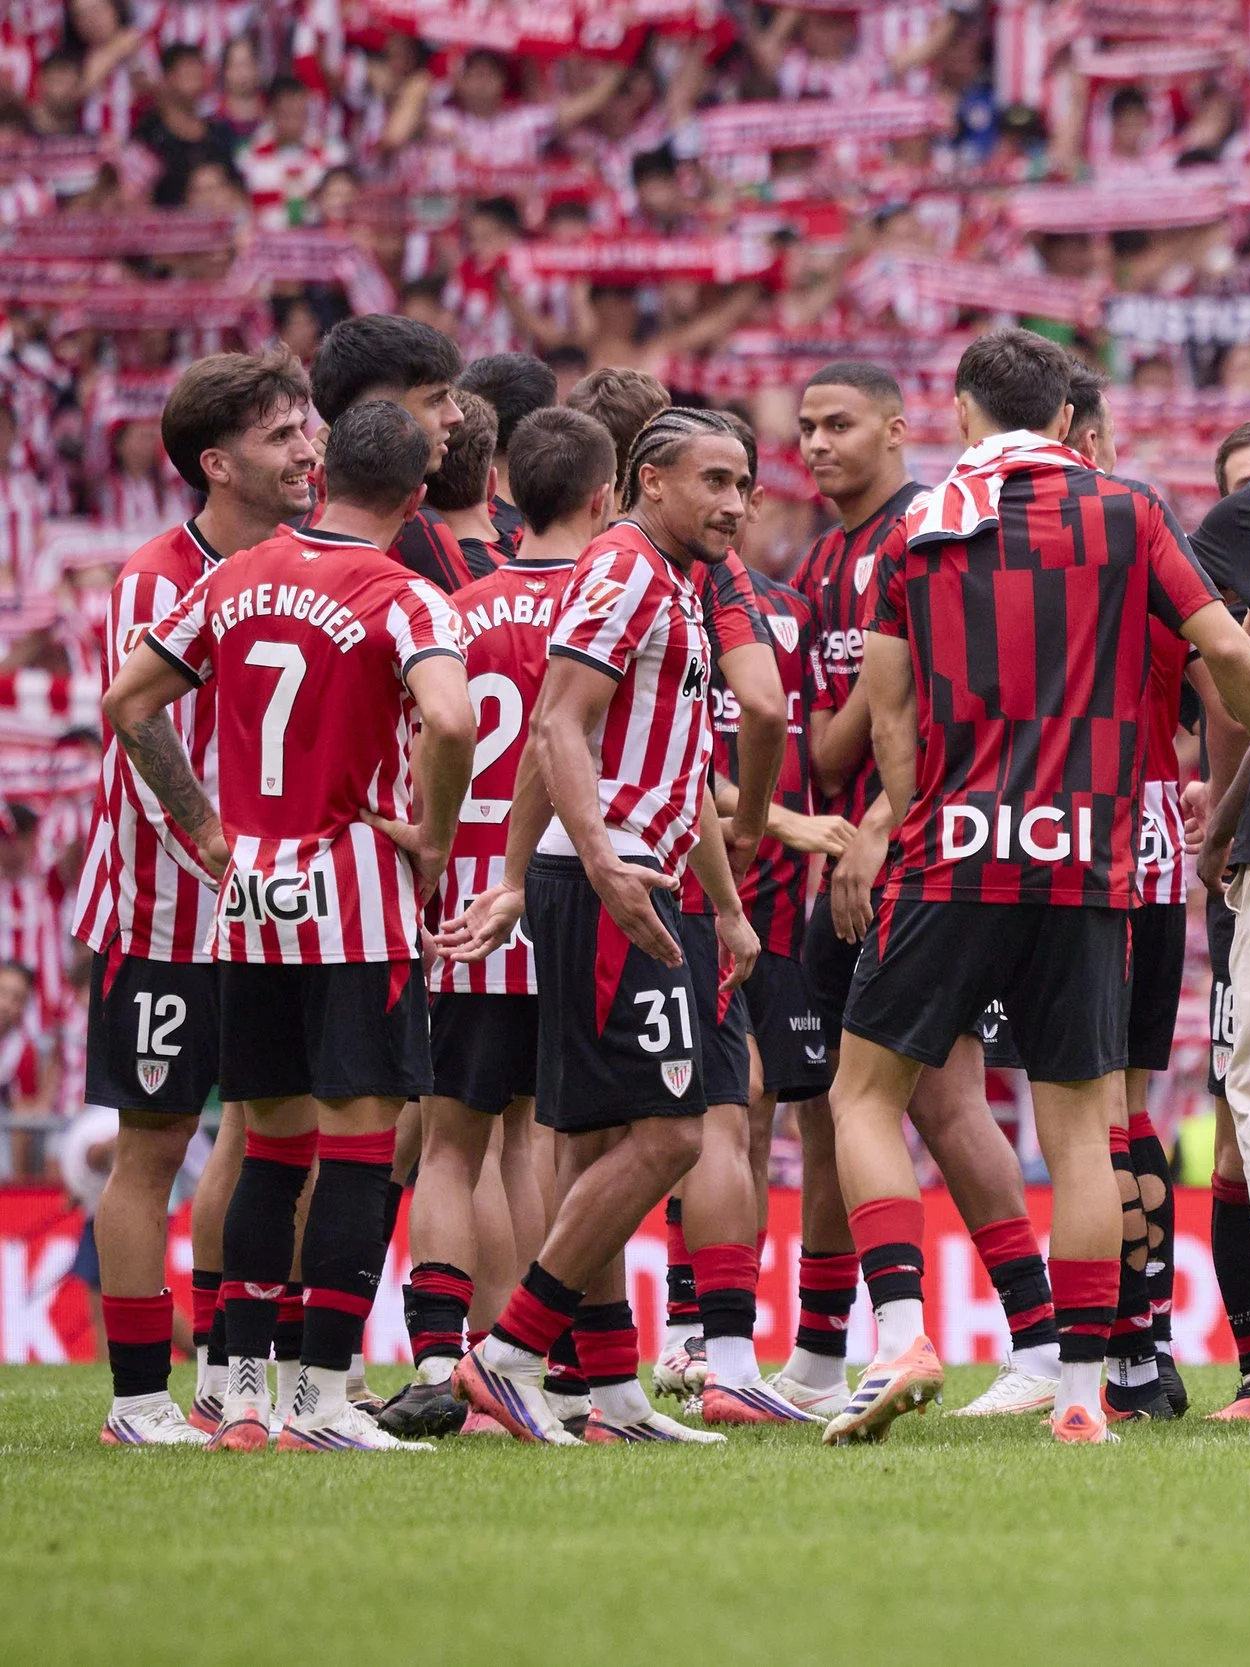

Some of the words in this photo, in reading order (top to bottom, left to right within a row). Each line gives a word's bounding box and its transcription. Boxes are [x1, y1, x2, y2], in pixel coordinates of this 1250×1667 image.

[211, 583, 367, 655] BERENGUER
[245, 641, 307, 797] 7
[942, 804, 1092, 862] DIGI
[225, 871, 328, 921] DIGI
[134, 992, 187, 1056] 12
[634, 987, 693, 1053] 31
